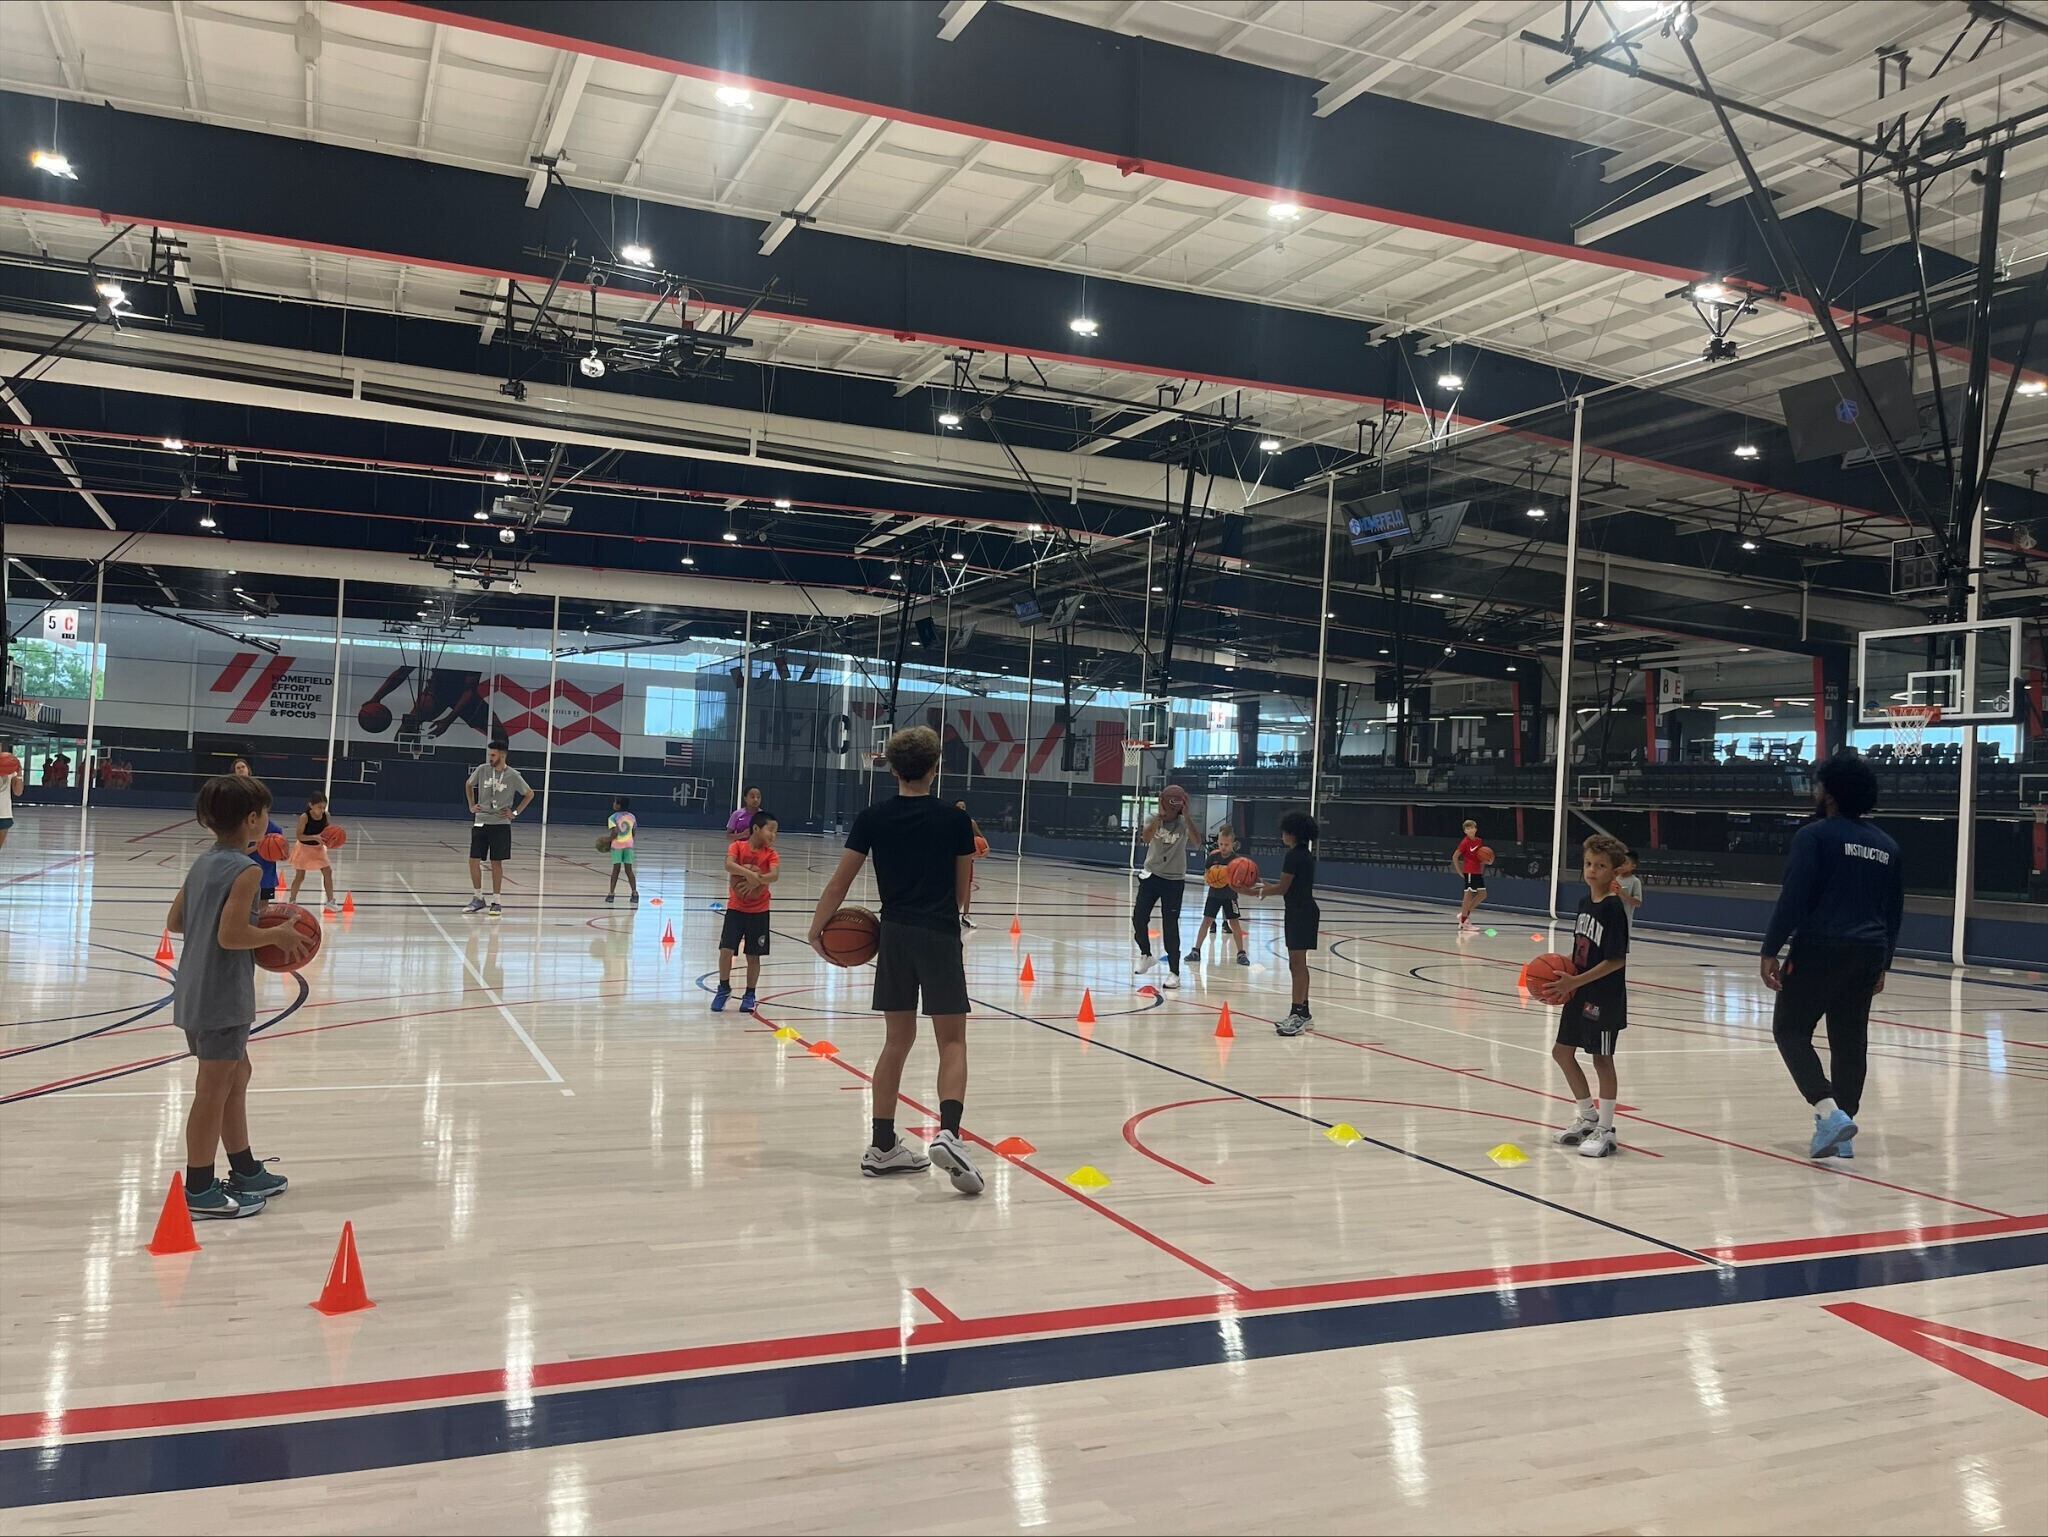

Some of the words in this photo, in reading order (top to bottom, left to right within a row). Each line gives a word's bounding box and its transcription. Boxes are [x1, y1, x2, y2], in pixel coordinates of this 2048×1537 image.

[48, 615, 57, 630] 5
[64, 616, 74, 631] C
[271, 674, 334, 686] HOMEFIELD
[271, 683, 312, 693] EFFORT
[1663, 678, 1669, 694] 8
[1675, 679, 1681, 695] E
[270, 691, 322, 702] ATTITUDE
[270, 700, 313, 710] ENERGY
[270, 708, 279, 717] &
[280, 709, 317, 719] FOCUS
